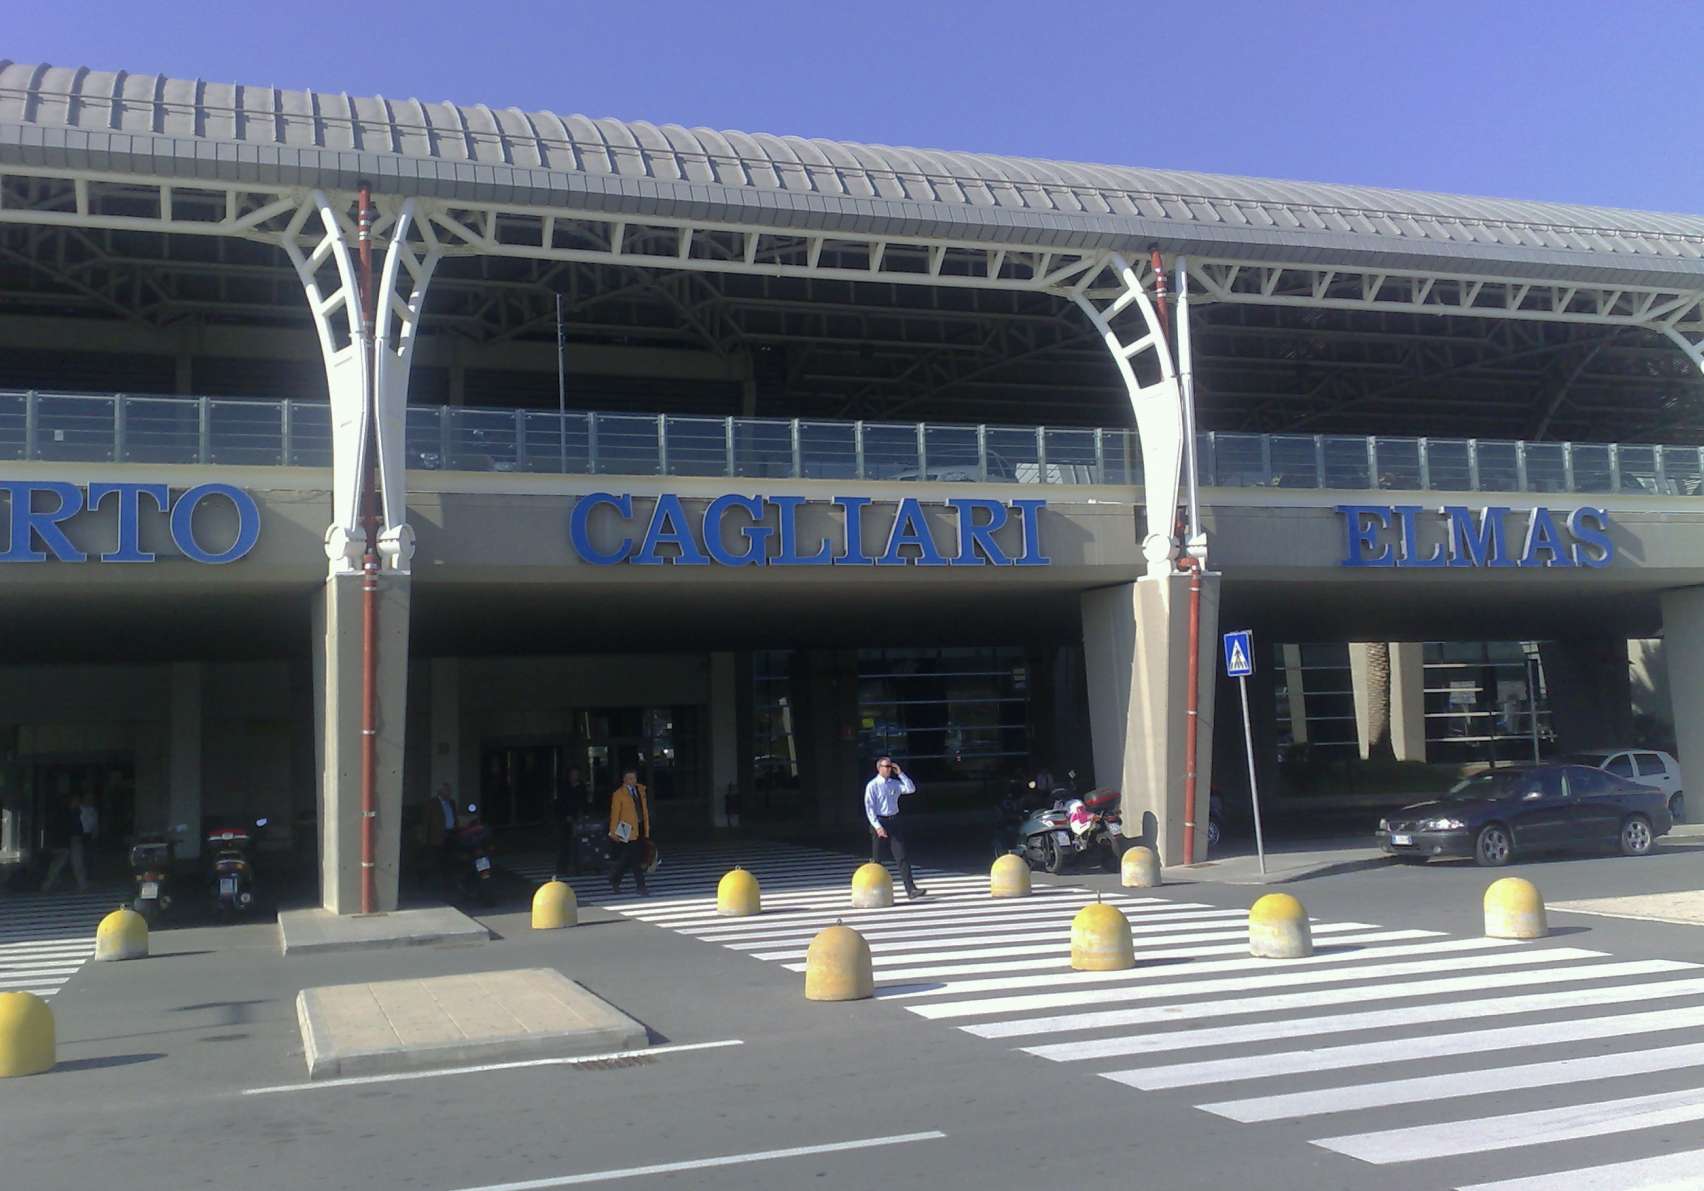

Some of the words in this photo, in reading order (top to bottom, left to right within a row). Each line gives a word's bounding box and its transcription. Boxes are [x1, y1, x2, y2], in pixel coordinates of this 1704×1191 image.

[0, 481, 260, 564] RTO
[569, 492, 1051, 567] CAGLIARI
[1334, 505, 1615, 569] ELMAS
